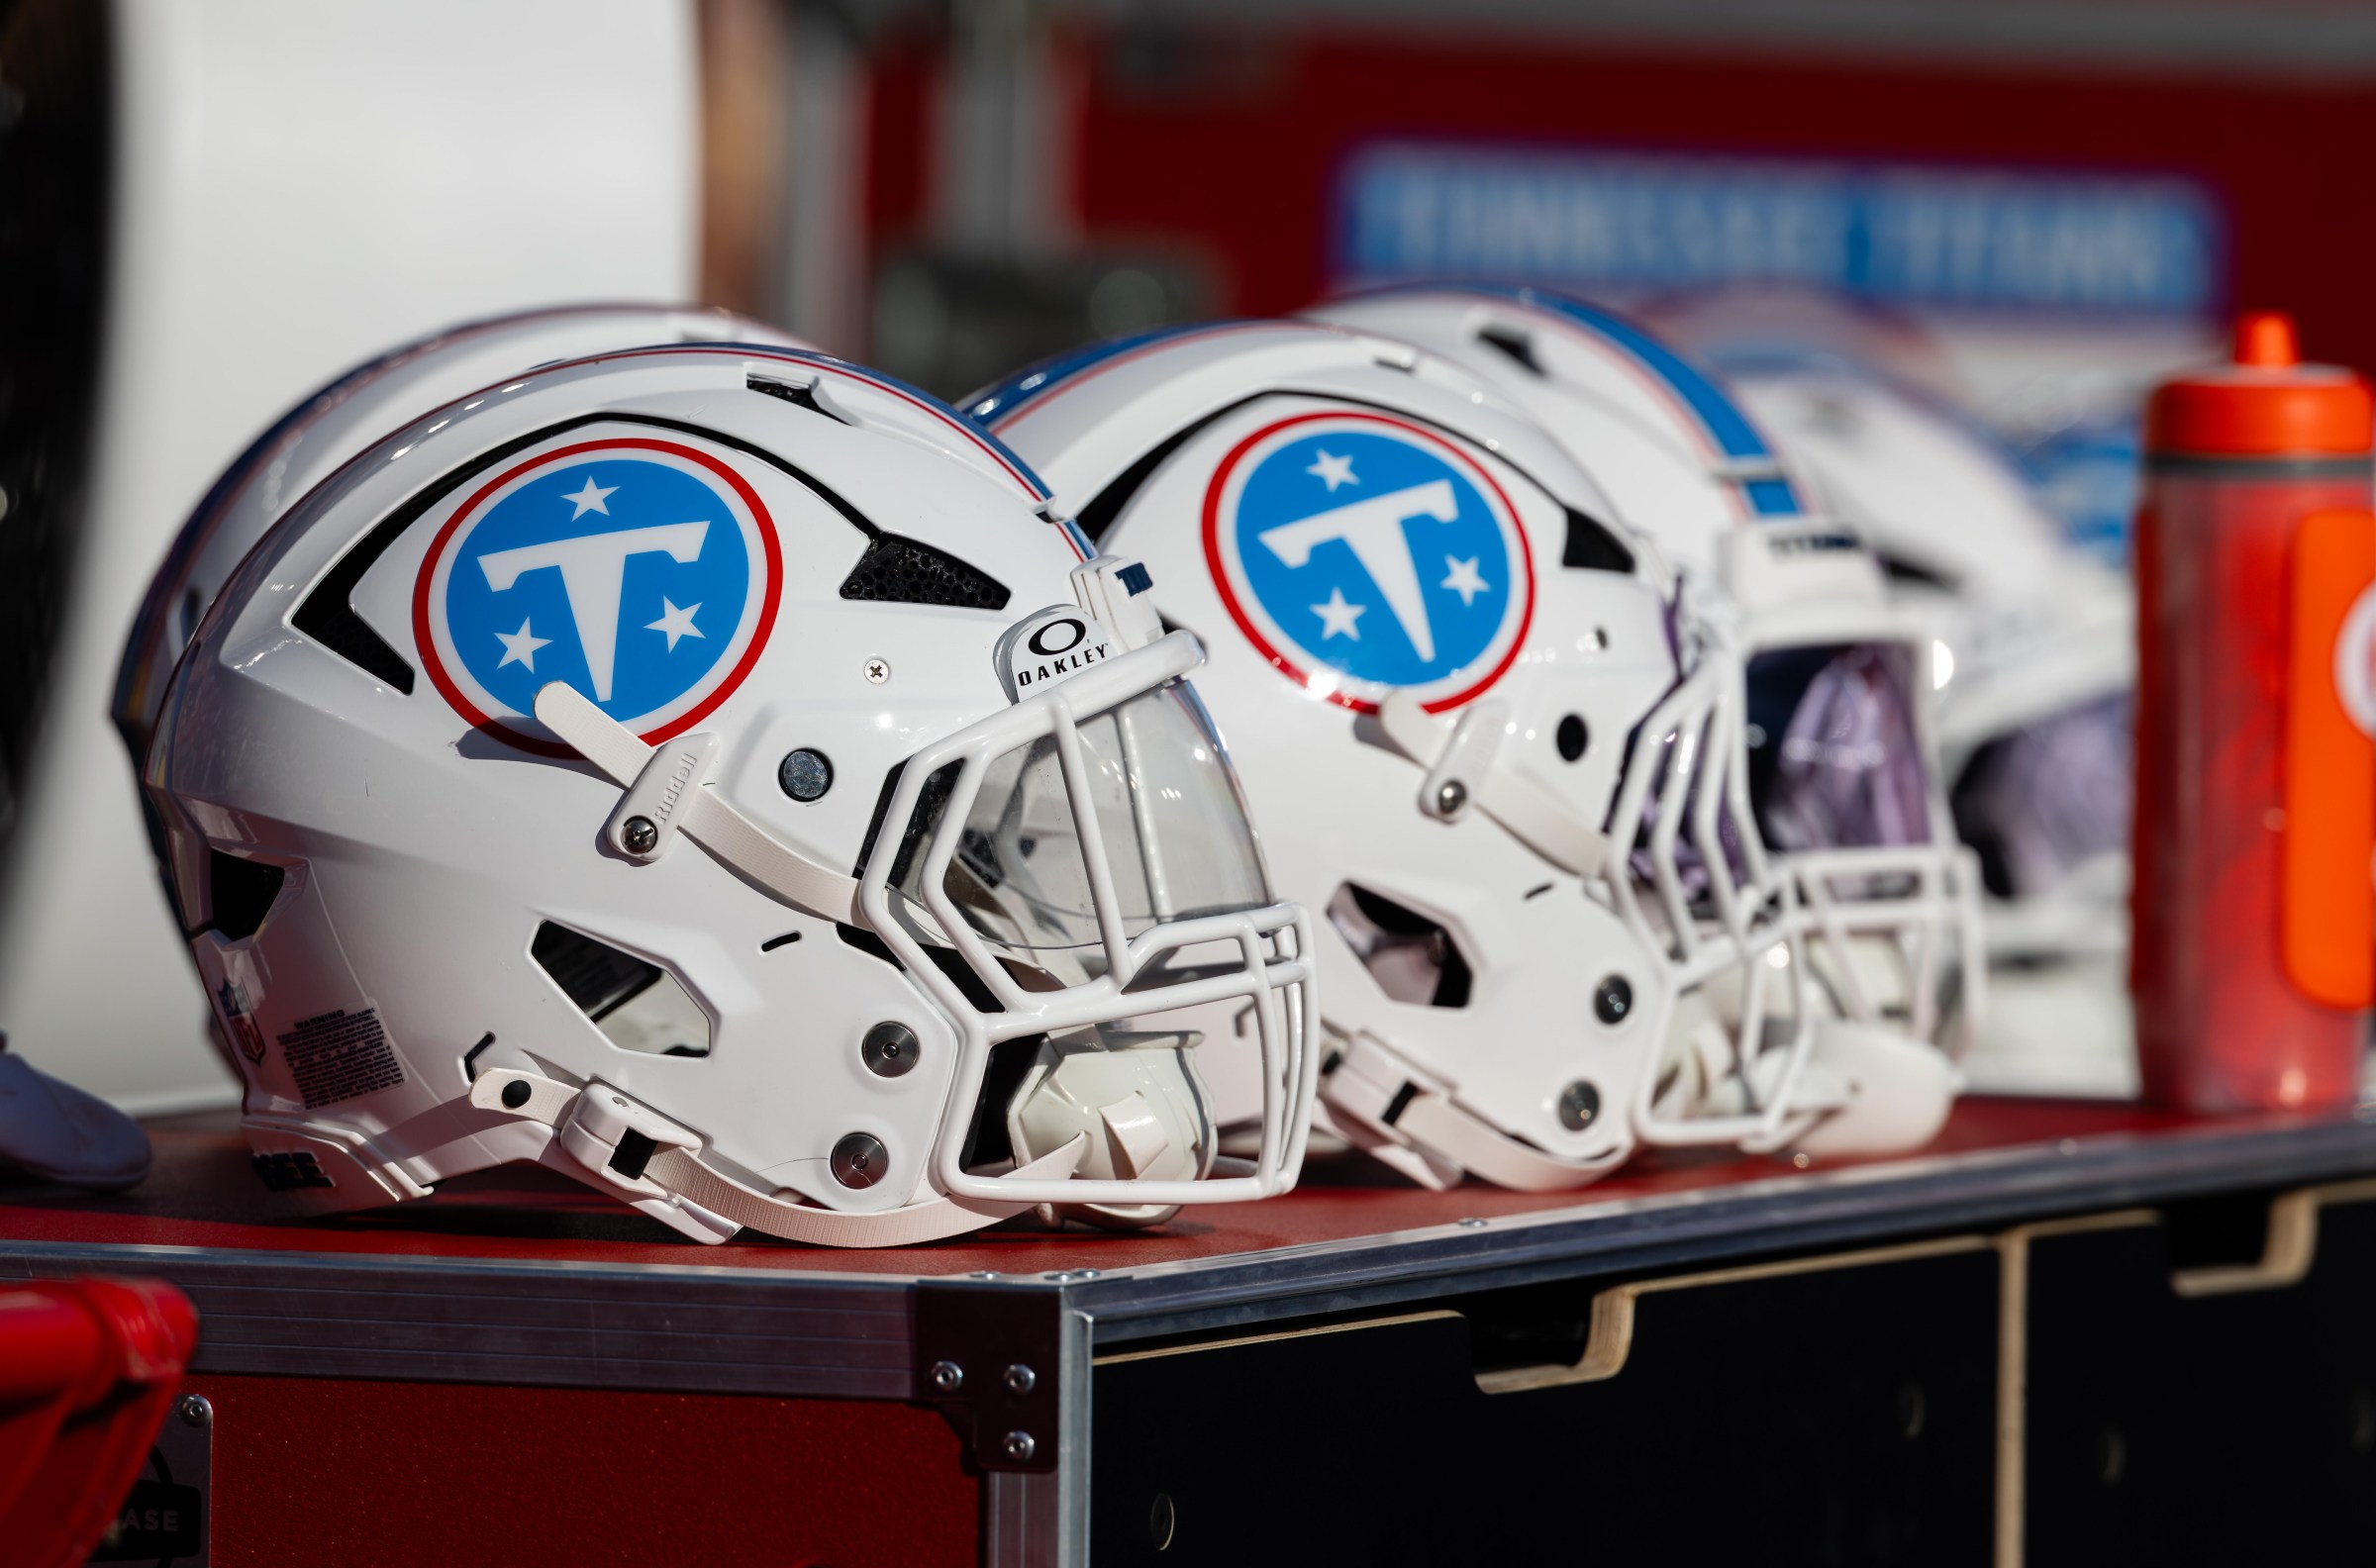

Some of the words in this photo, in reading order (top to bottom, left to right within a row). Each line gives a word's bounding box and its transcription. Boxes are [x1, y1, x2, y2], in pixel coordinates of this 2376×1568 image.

[1257, 478, 1459, 663] T
[476, 520, 711, 703] T
[1018, 643, 1106, 687] OAKLEY
[654, 752, 698, 824] Riddell
[294, 1009, 345, 1029] WARNING
[120, 1508, 179, 1532] ASE
